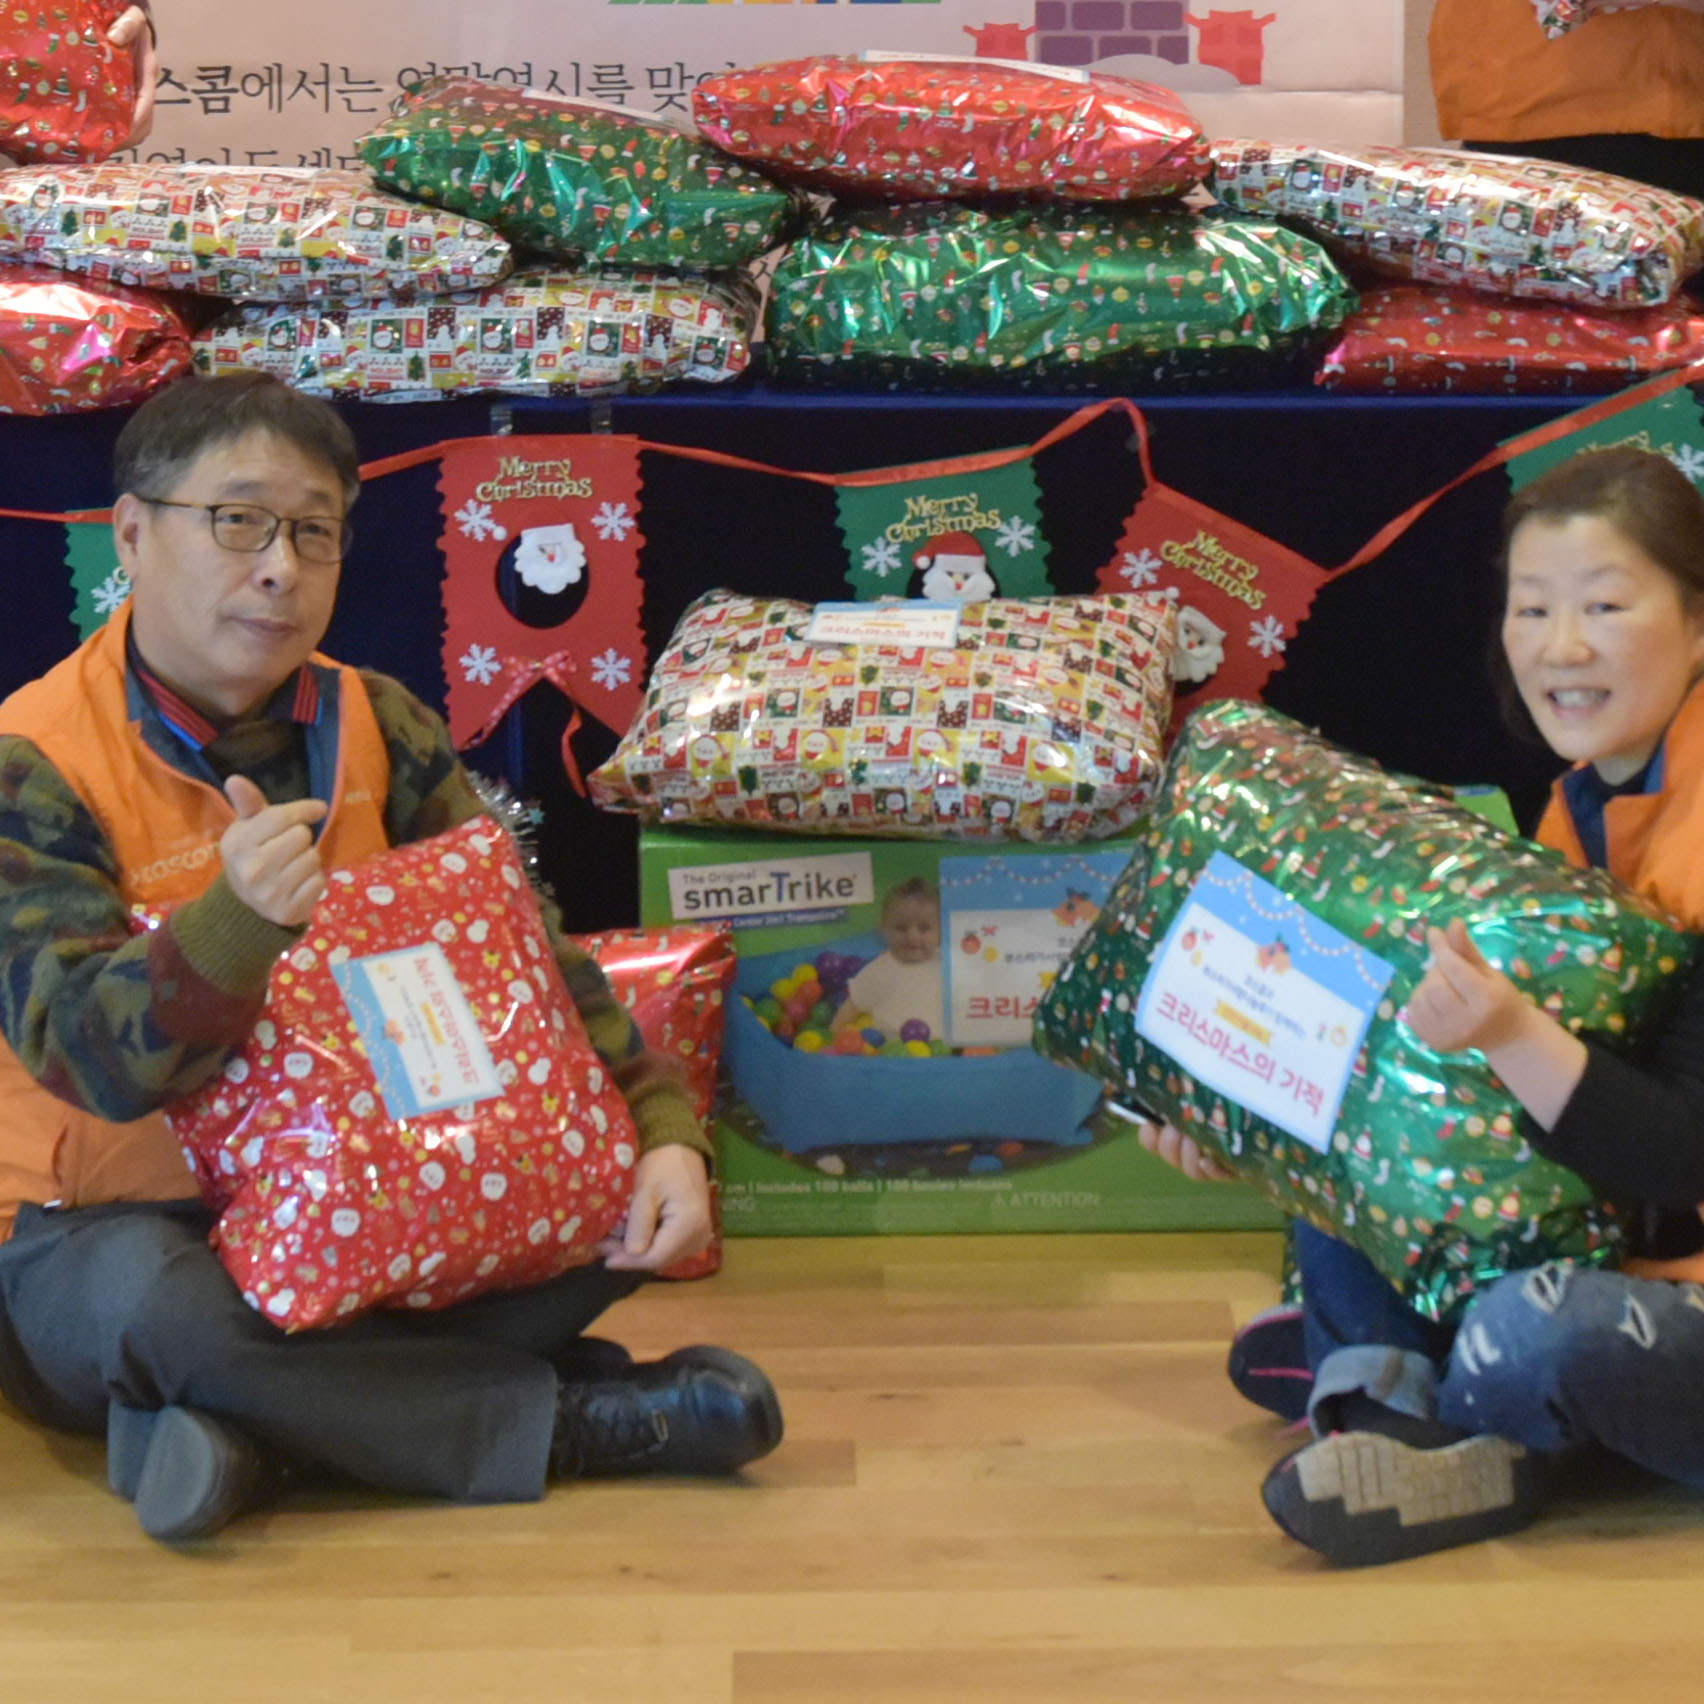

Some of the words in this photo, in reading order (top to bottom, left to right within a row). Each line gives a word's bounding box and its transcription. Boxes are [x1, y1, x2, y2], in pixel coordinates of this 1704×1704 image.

[498, 455, 572, 478] Merry
[476, 478, 593, 502] Christmas
[904, 492, 978, 517] Merry
[1197, 529, 1259, 580] Merry
[683, 873, 705, 884] The
[708, 869, 757, 884] Original
[1156, 991, 1277, 1085] 크리스마스의
[1281, 1069, 1325, 1118] 기적
